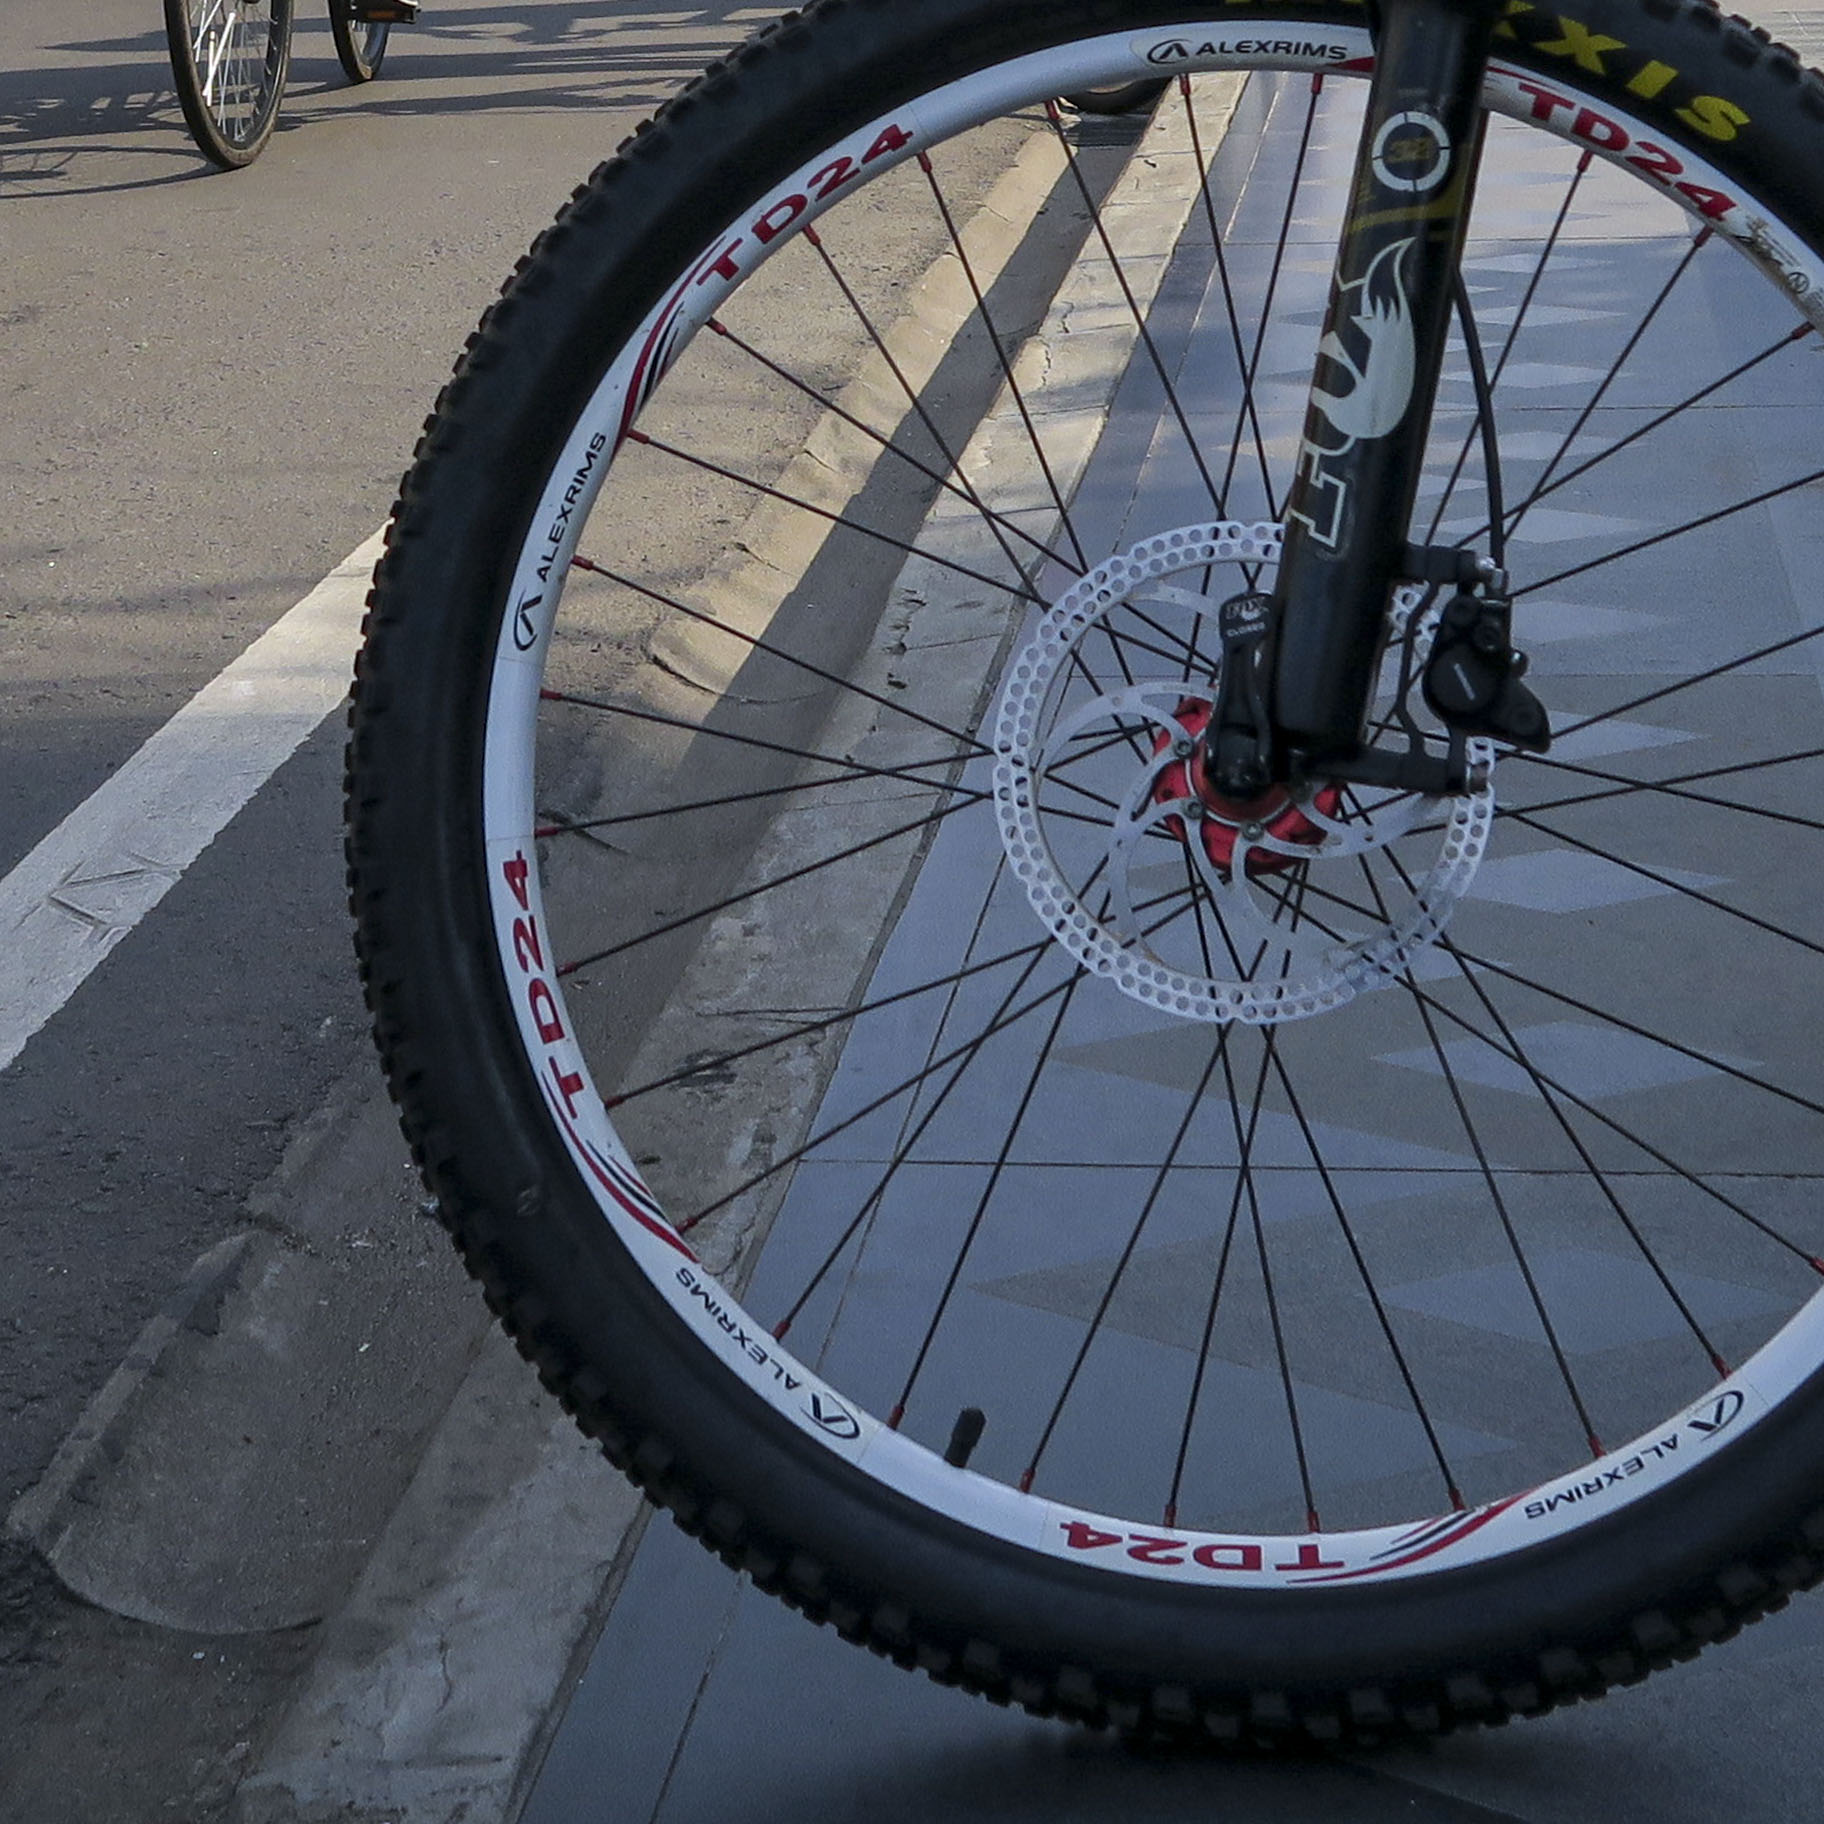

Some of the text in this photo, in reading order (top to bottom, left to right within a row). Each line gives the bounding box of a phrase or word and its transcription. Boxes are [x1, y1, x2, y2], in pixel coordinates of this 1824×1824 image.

[1195, 40, 1348, 60] ALEXRIMS
[695, 123, 913, 287] TD24
[1516, 82, 1738, 223] TD24
[537, 432, 607, 582] ALEXRIMS
[503, 851, 584, 1120] TD24
[678, 1268, 801, 1388] ALEXRIMS
[1524, 1434, 1679, 1520] ALEXRIMS
[1058, 1520, 1347, 1572] TD24
